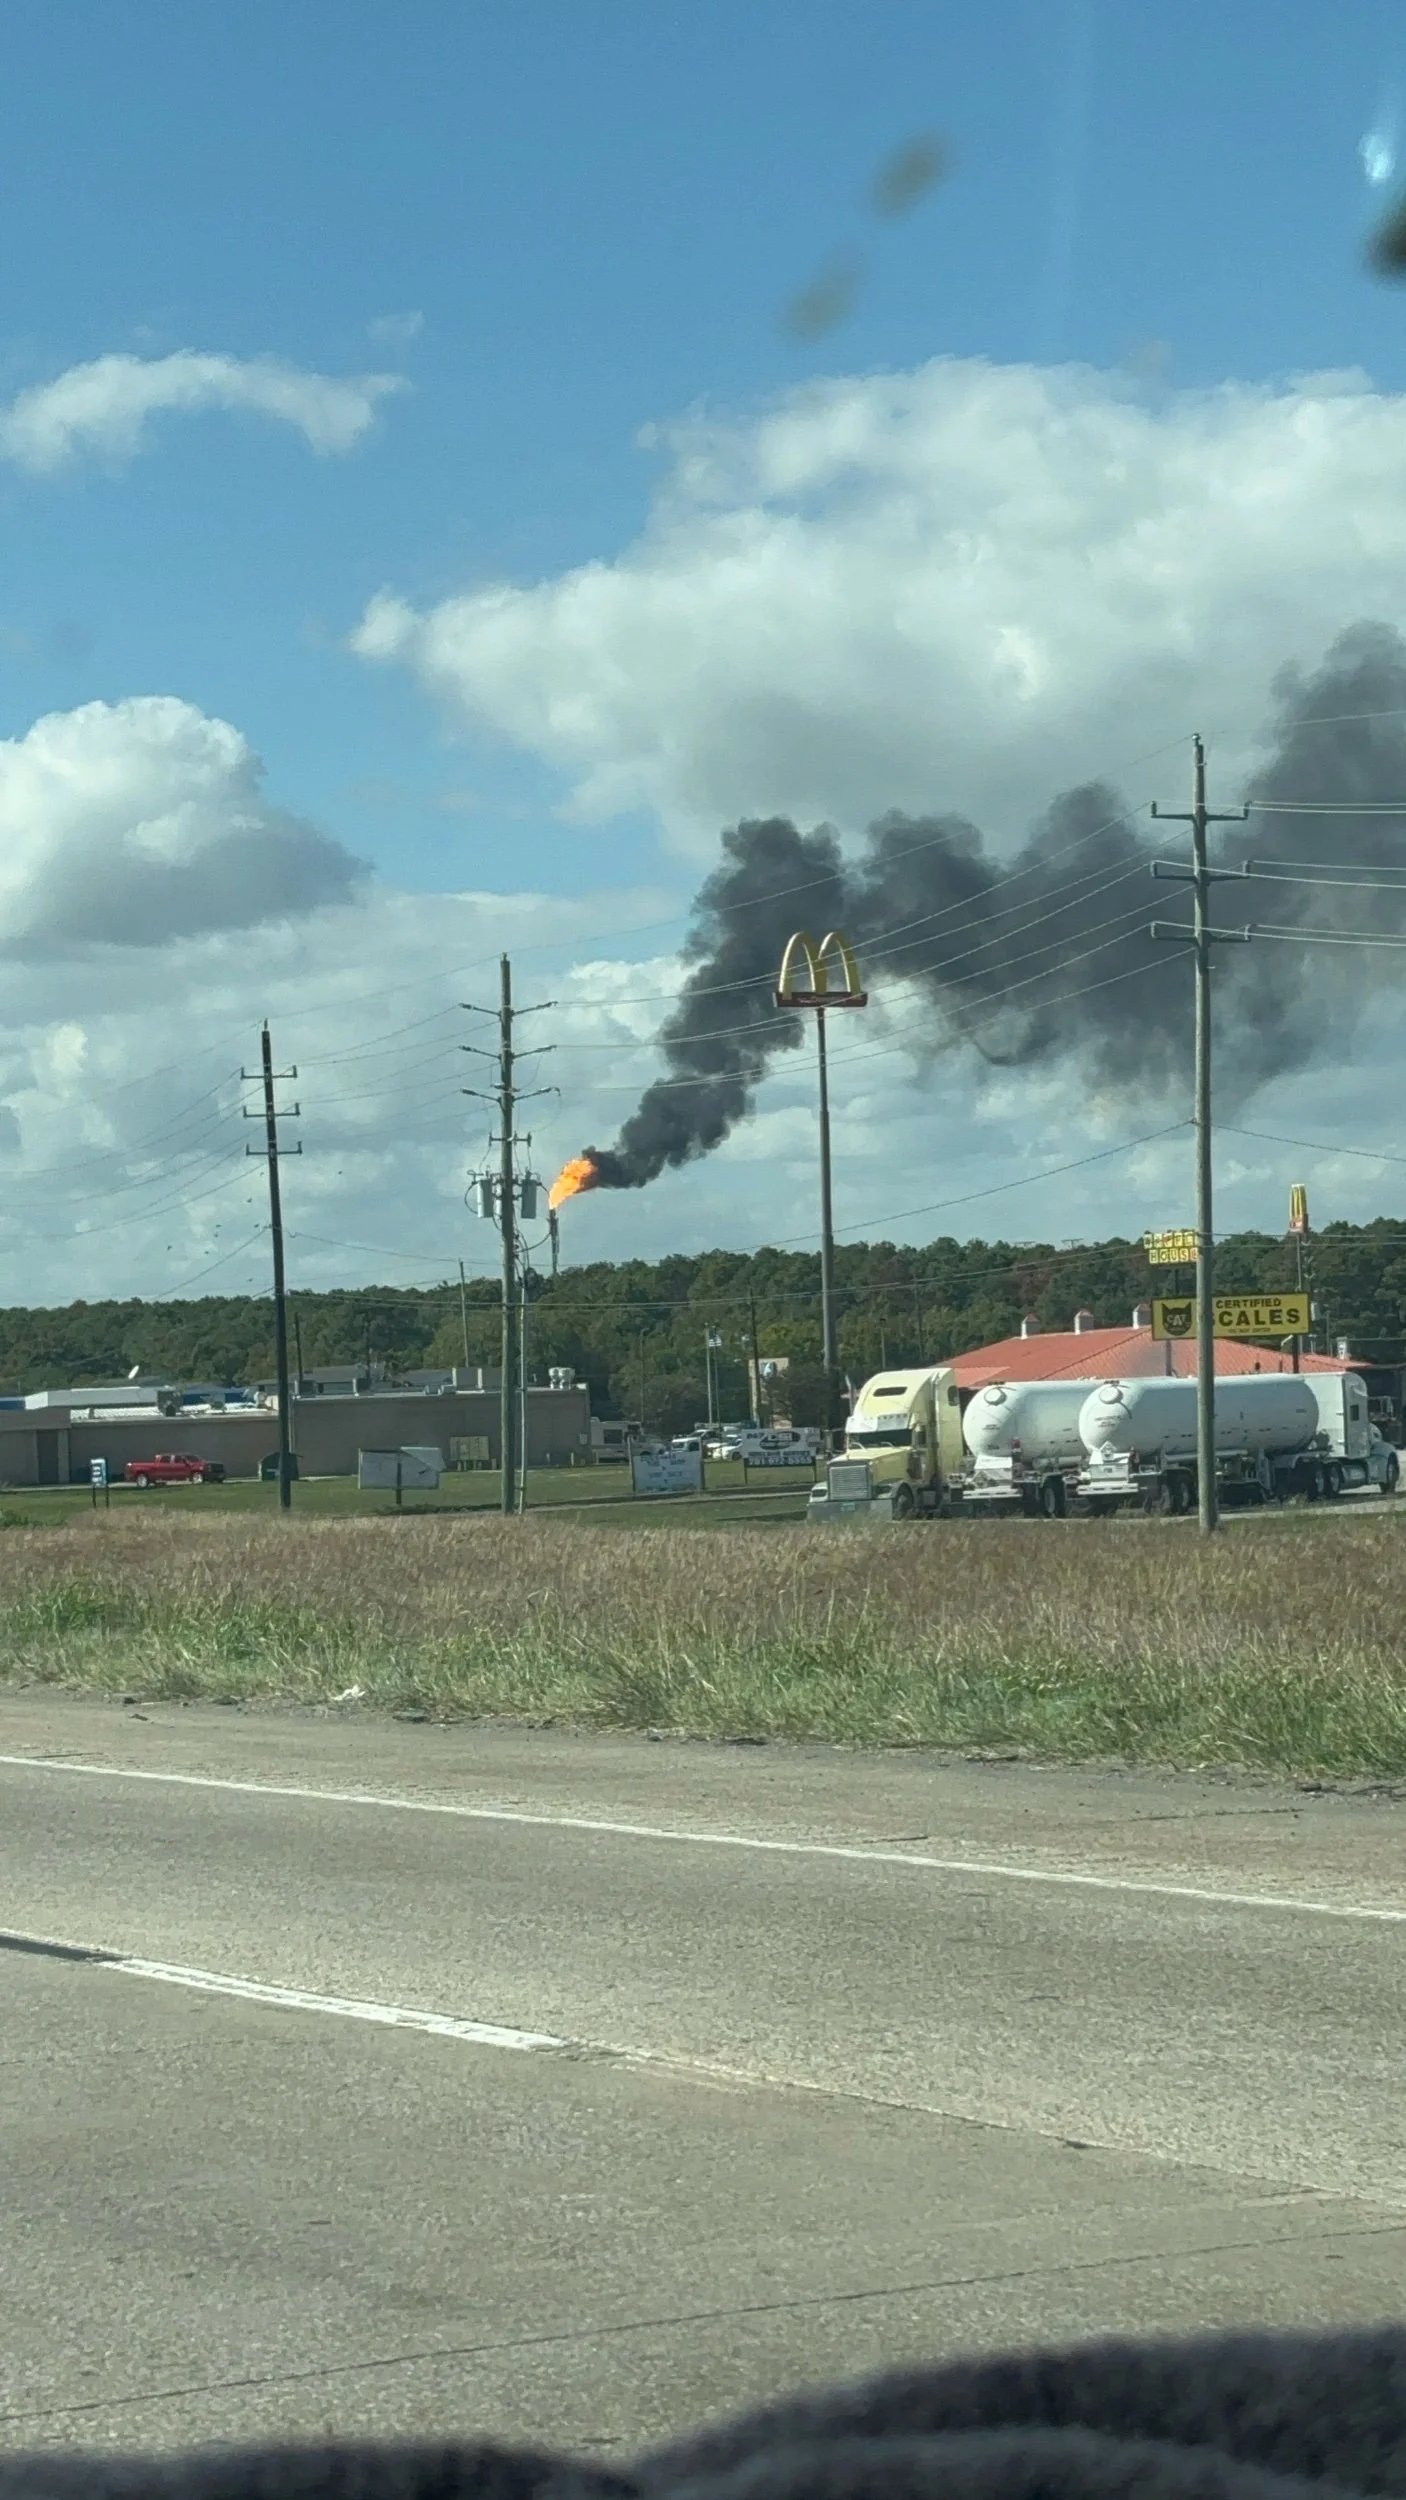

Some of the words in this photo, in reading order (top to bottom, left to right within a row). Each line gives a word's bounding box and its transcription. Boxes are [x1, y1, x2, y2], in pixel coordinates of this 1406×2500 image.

[1144, 1232, 1195, 1248] WAFFL
[1215, 1297, 1281, 1309] CERTIFIED
[1166, 1314, 1186, 1326] CAT
[1213, 1308, 1300, 1326] CALES
